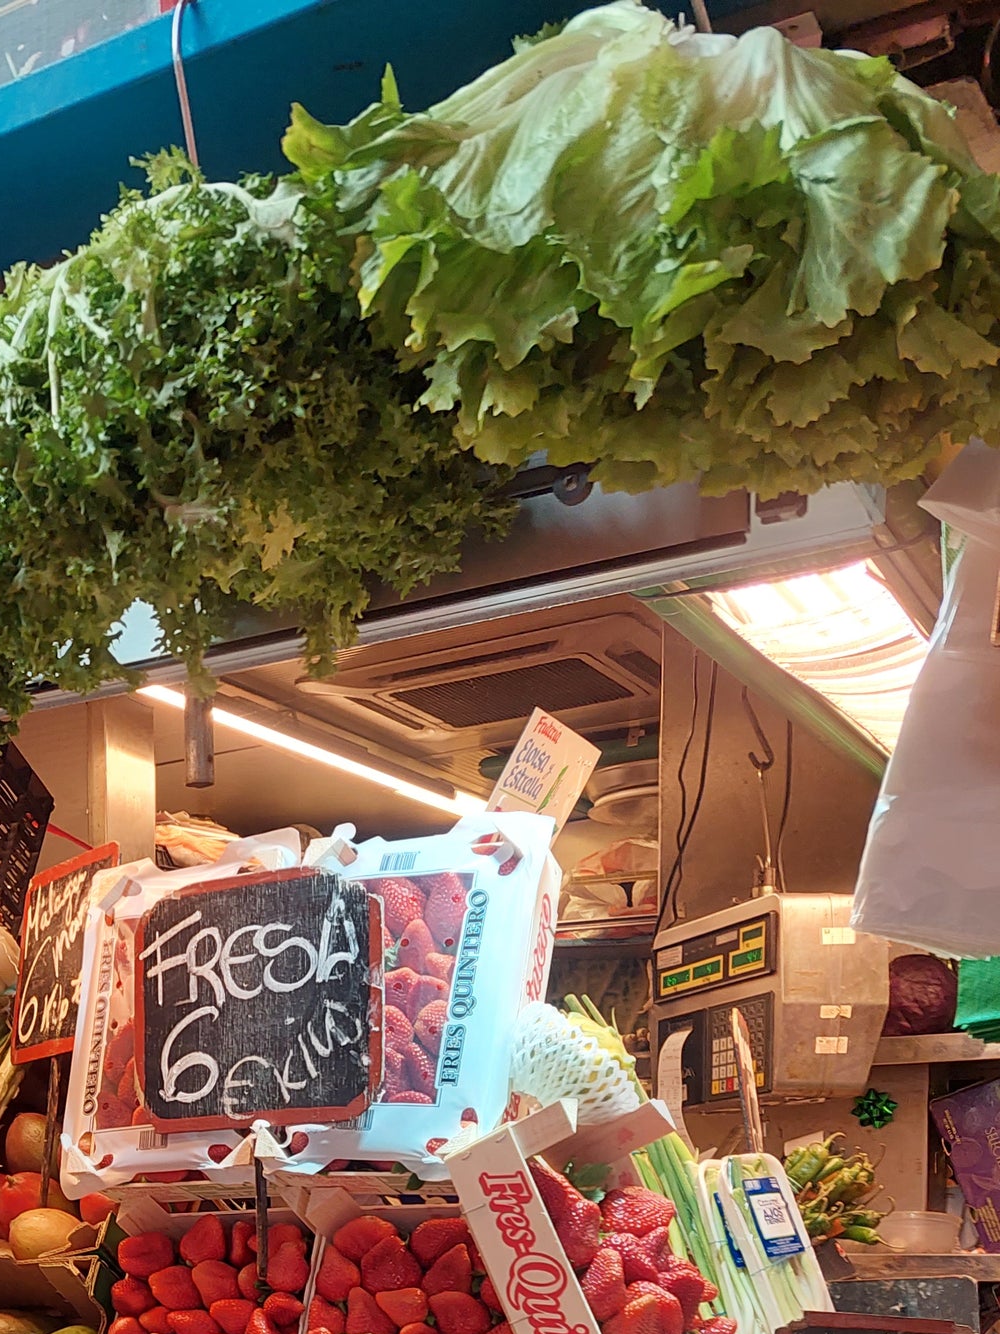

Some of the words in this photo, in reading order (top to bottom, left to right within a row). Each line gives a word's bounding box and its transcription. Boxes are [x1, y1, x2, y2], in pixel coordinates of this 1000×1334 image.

[18, 936, 52, 1044] 6
[139, 899, 360, 1007] FRESA
[450, 889, 490, 1020] QUINTERO
[159, 1006, 220, 1103] 6
[440, 1024, 466, 1086] FRES
